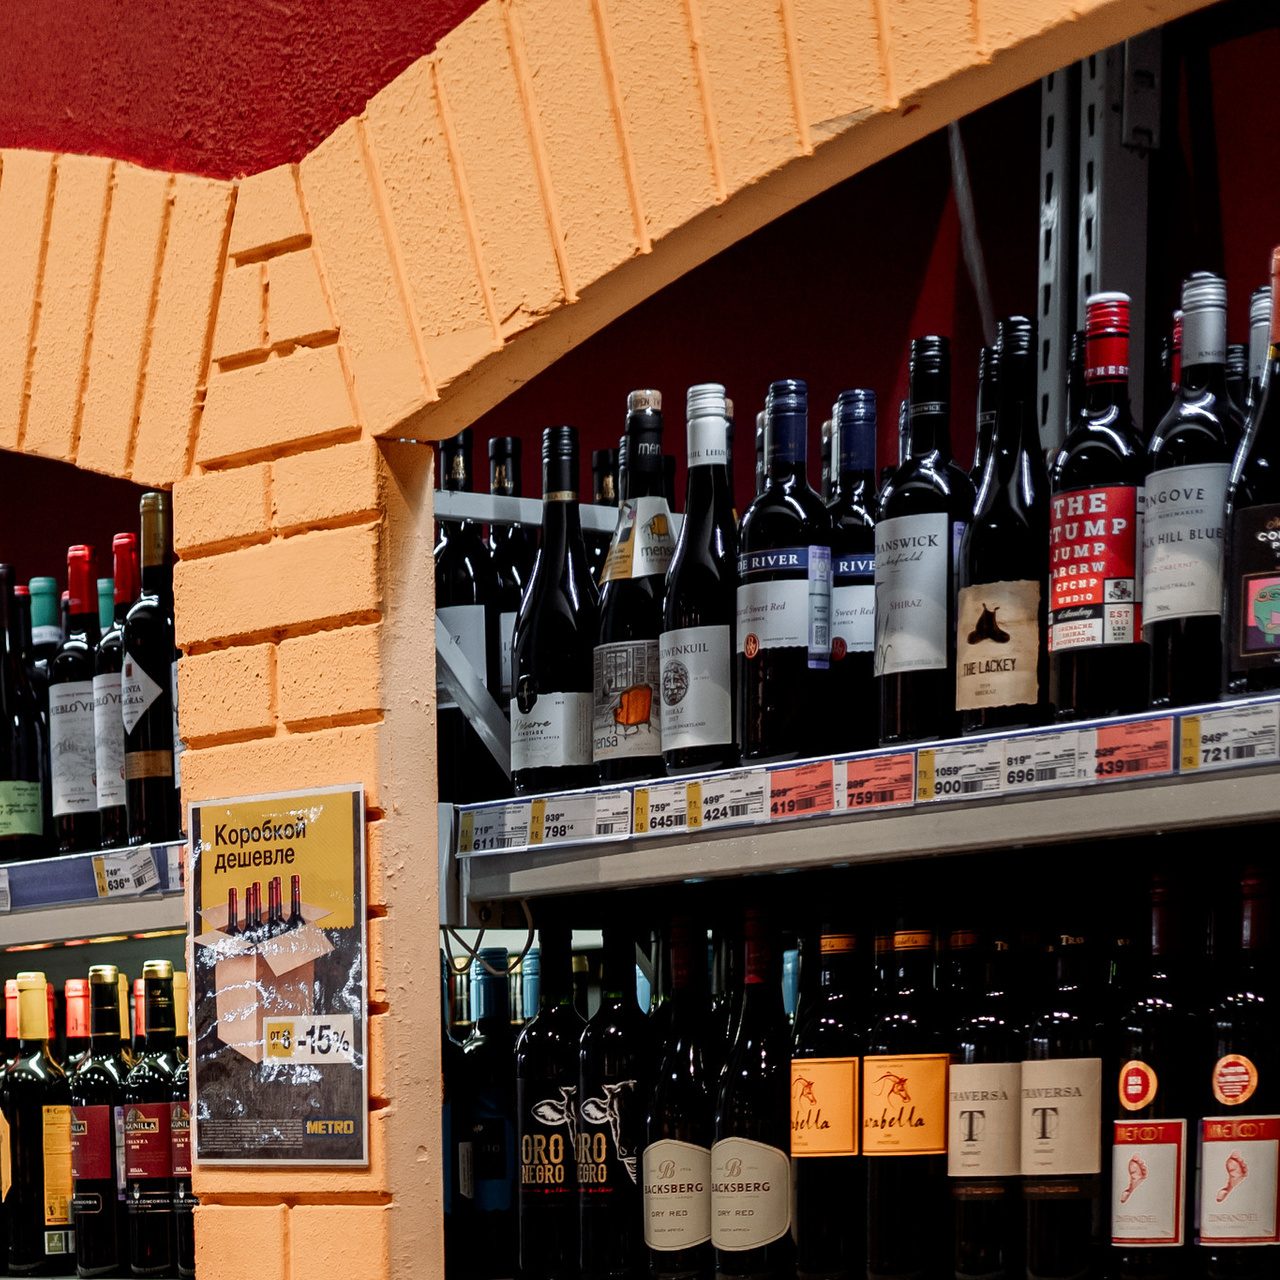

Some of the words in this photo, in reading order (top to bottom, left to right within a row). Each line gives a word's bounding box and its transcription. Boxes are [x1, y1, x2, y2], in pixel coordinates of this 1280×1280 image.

[1054, 492, 1106, 519] THE
[1158, 531, 1183, 545] HILL
[1189, 527, 1224, 540] BLUE
[1053, 542, 1106, 562] JUMP
[752, 554, 799, 568] RIVER
[1053, 561, 1105, 579] ARGRW
[770, 601, 786, 612] Red
[889, 598, 923, 610] SHIRAZ
[1109, 610, 1130, 618] EST
[963, 661, 976, 676] THE
[978, 657, 1017, 675] LACKEY
[1202, 746, 1231, 763] 721
[1095, 759, 1125, 775] 439
[1007, 768, 1035, 784] 696
[934, 780, 961, 795] 900
[848, 790, 872, 807] 759
[704, 807, 728, 822] 424
[770, 799, 795, 815] 419
[649, 815, 673, 829] 645
[214, 815, 306, 848] Коробкой
[545, 825, 567, 838] 798
[214, 846, 295, 873] дешевле
[306, 1120, 354, 1135] METRO
[959, 1110, 986, 1142] T
[1032, 1107, 1059, 1139] T
[521, 1133, 564, 1164] ORO
[521, 1164, 565, 1184] NEGRO
[669, 1209, 688, 1217] RED
[735, 1209, 754, 1217] RED
